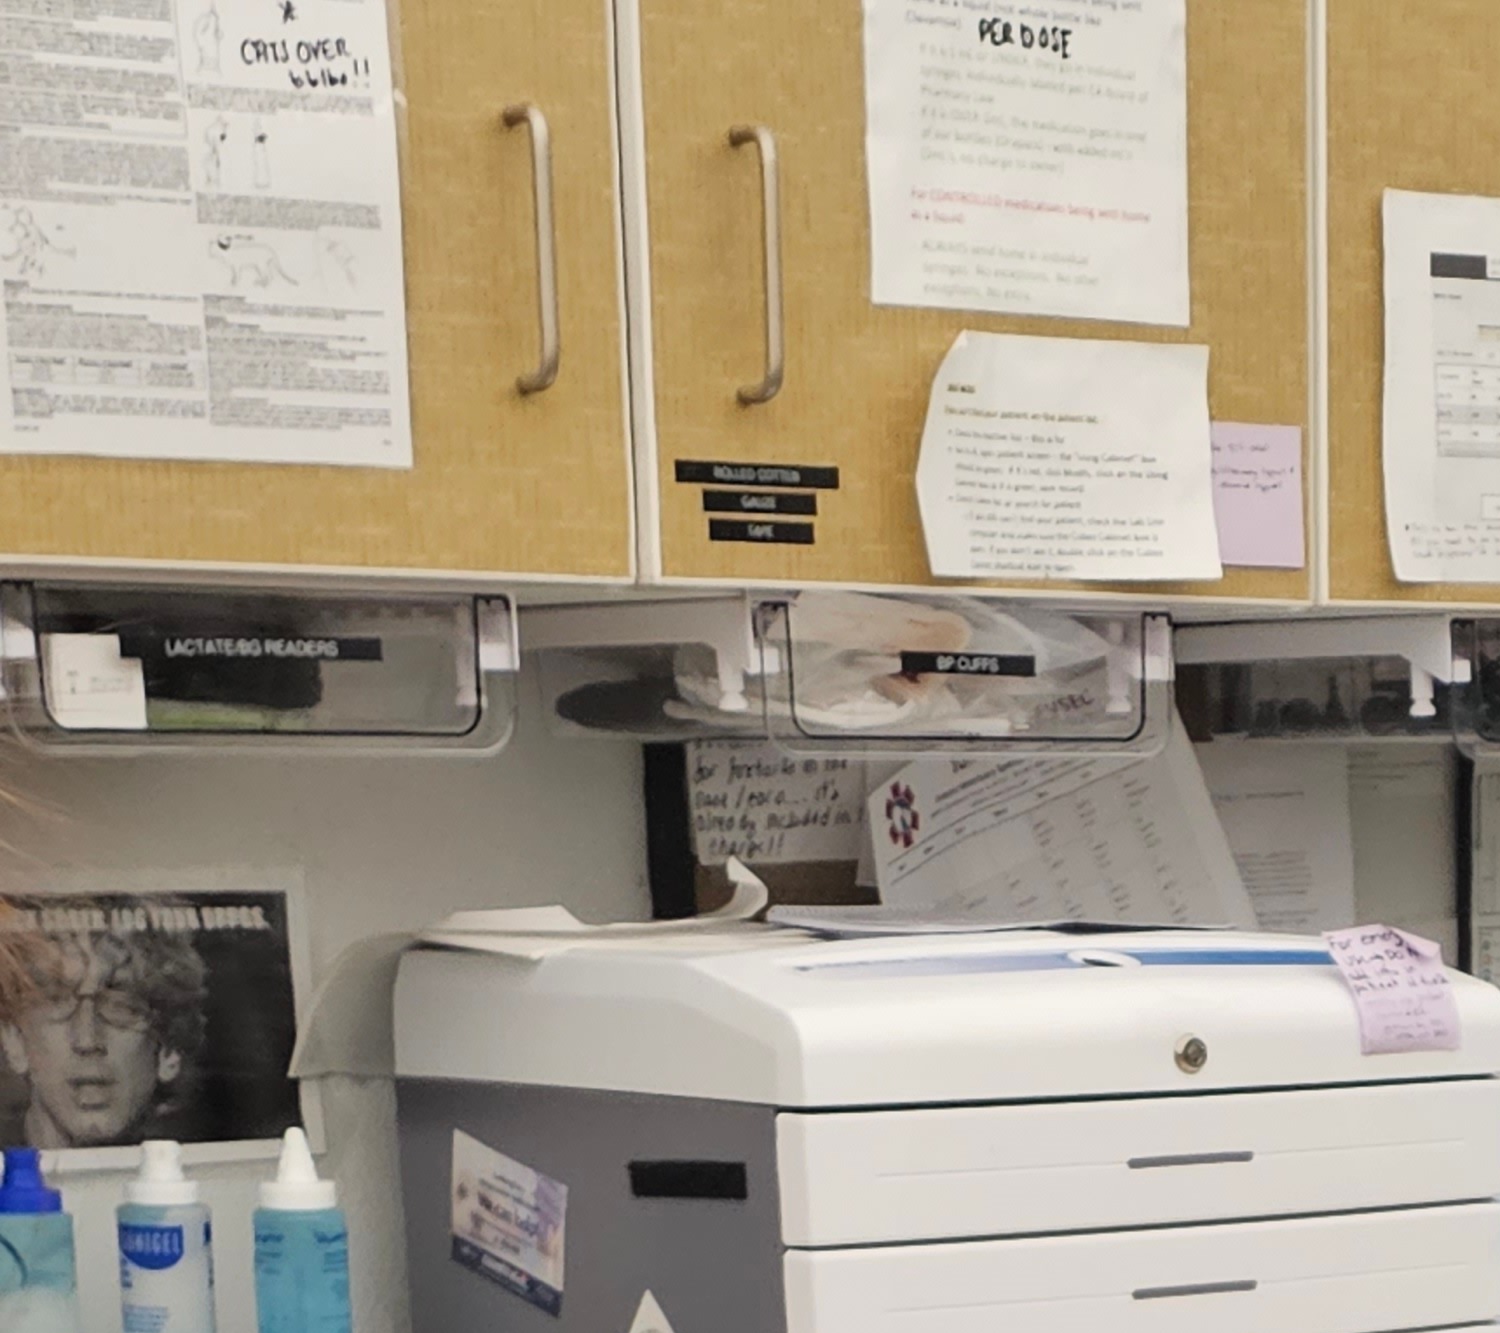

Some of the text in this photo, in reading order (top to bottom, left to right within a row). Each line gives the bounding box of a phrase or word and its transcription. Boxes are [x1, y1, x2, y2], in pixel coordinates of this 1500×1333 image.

[979, 17, 1072, 59] PER DOSE
[241, 38, 350, 65] CATS OVER
[264, 638, 339, 659] READERS
[936, 654, 1000, 673] BP CUFFS
